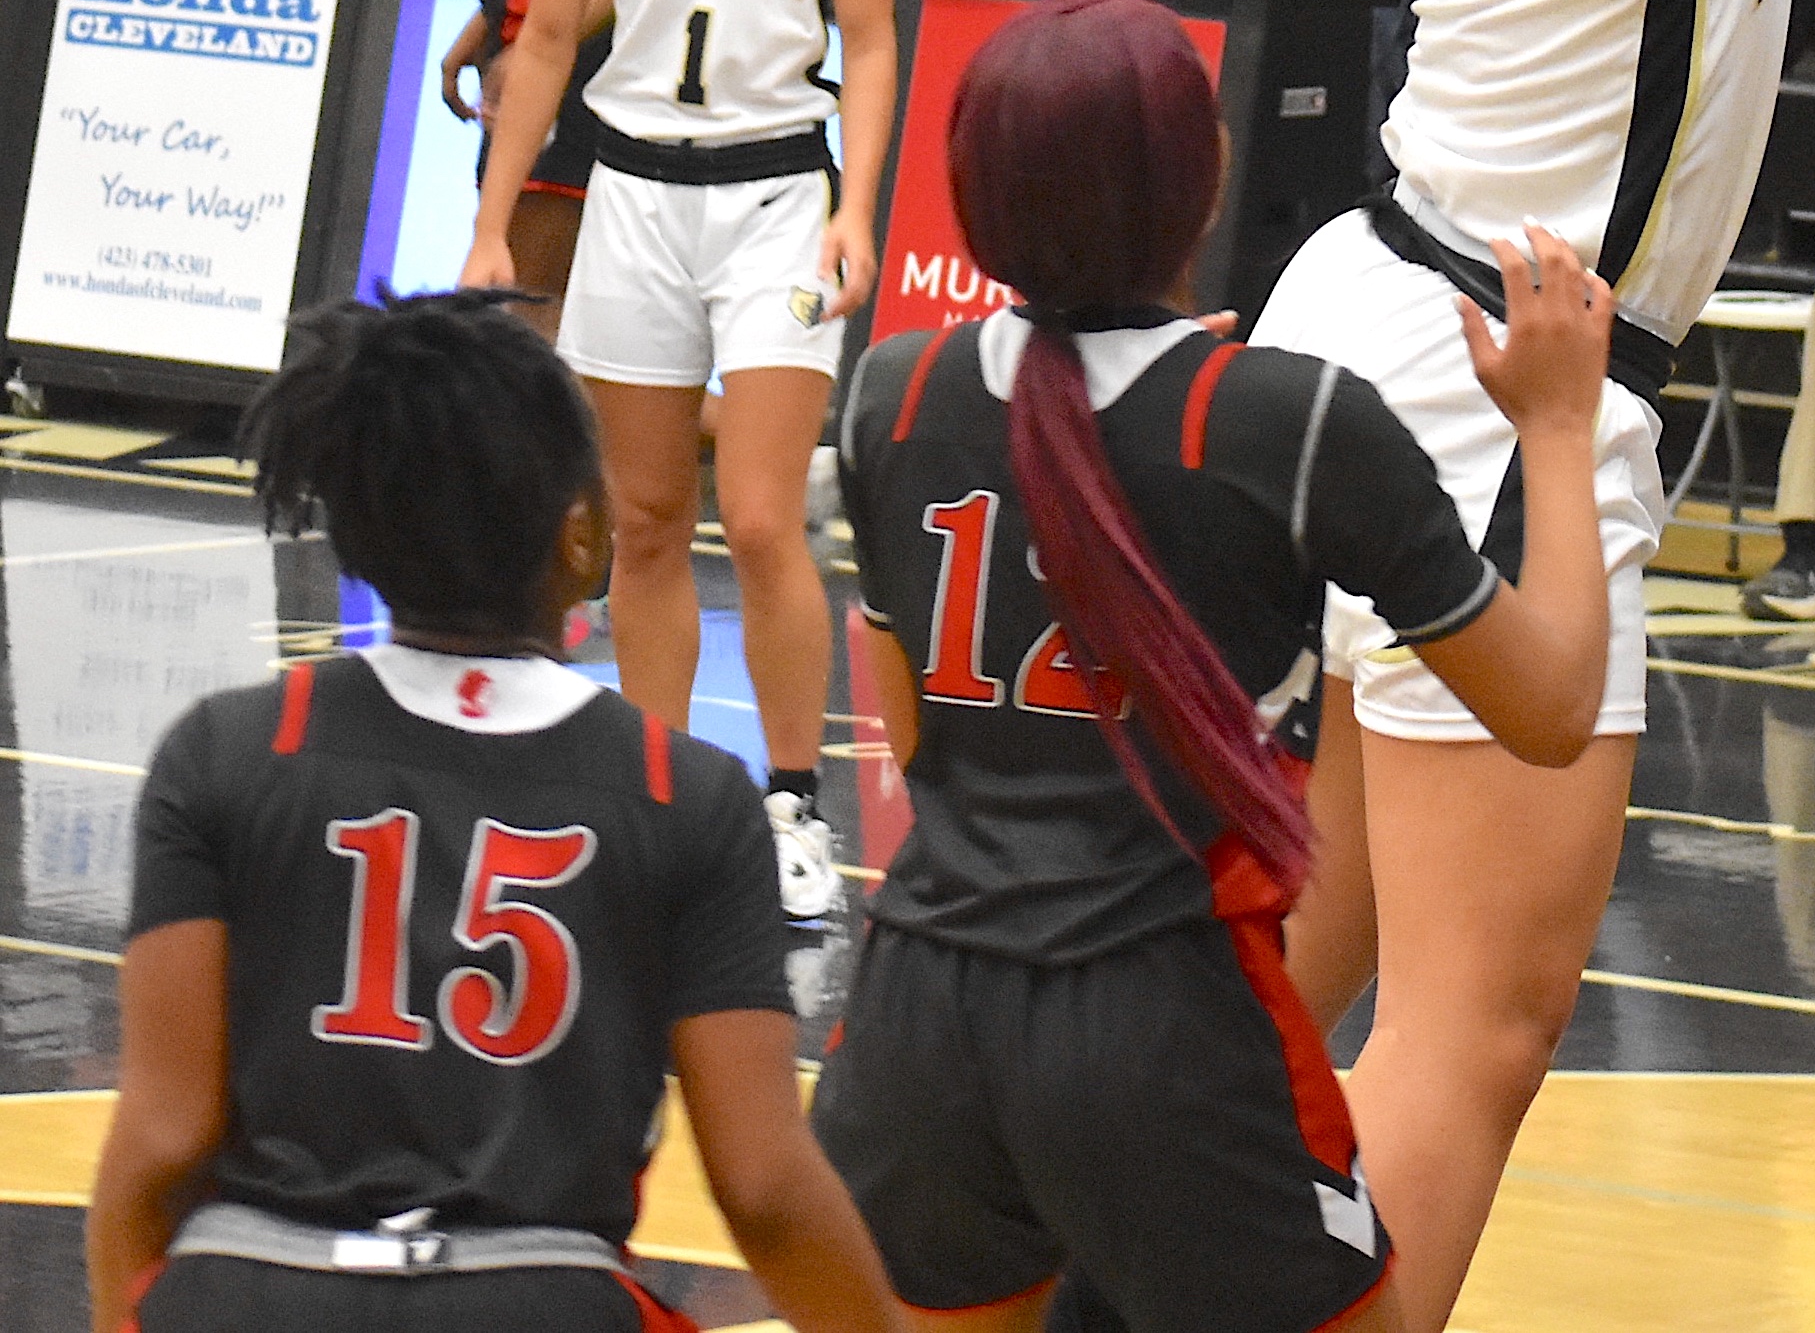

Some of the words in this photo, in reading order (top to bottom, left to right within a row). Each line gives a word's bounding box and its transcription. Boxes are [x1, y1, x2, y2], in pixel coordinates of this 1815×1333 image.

[68, 13, 315, 64] CLEVELAND
[676, 7, 711, 106] 1
[162, 119, 231, 160] Car,
[101, 171, 175, 213] Your
[98, 245, 138, 269] (423)
[142, 250, 213, 279] 478-5301
[43, 271, 263, 312] www.hondaofcleveland.com
[310, 806, 599, 1067] 15
